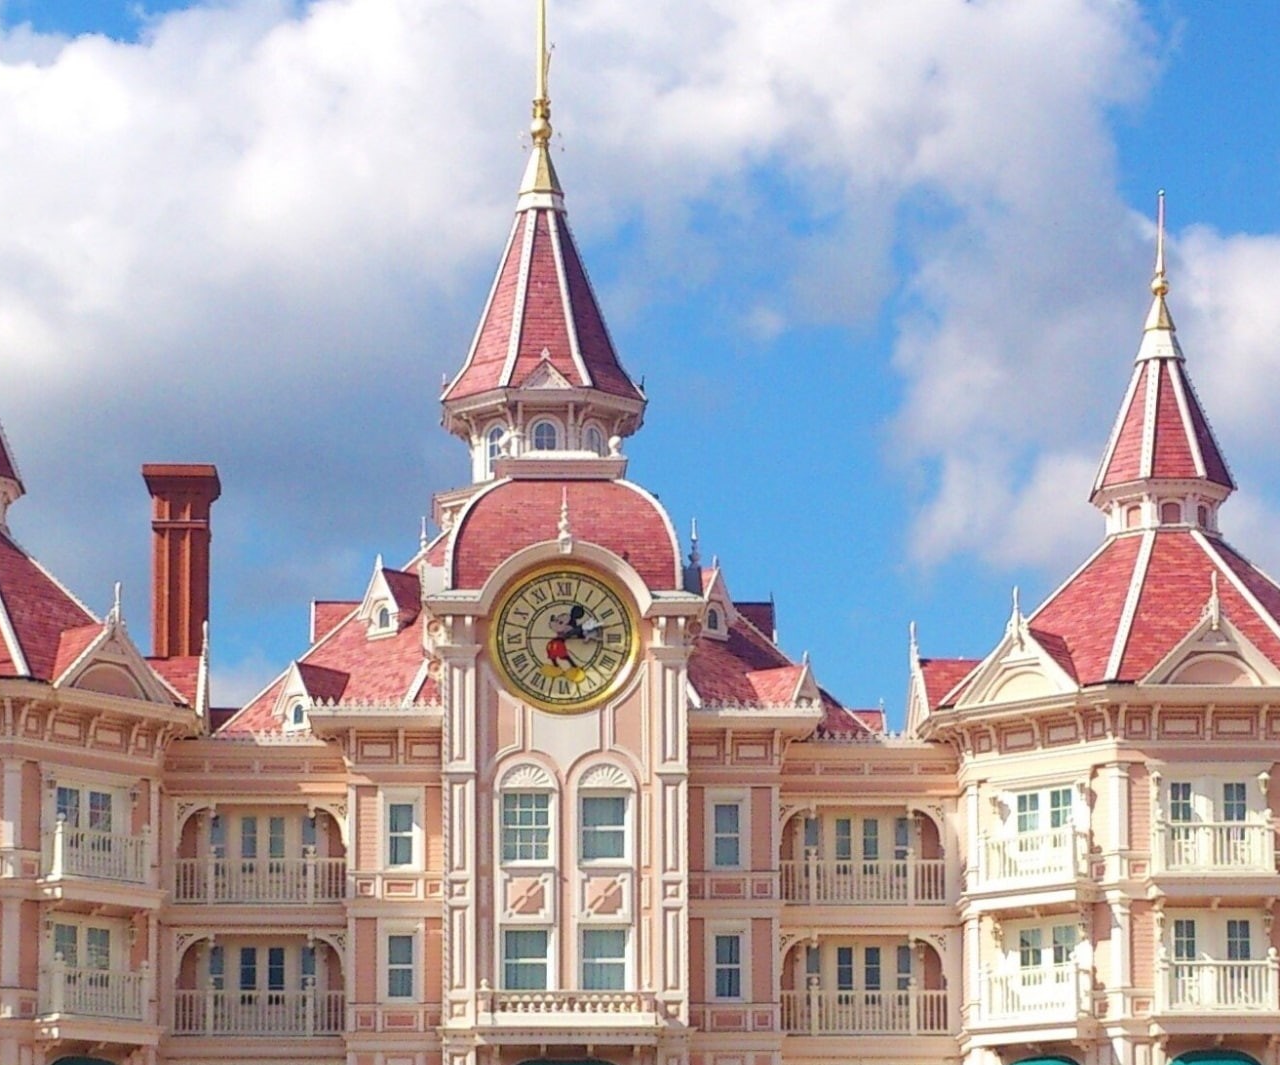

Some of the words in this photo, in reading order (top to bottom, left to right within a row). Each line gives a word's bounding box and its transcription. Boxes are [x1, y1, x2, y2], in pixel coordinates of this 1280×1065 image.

[556, 581, 572, 596] XII
[531, 587, 547, 604] XI
[600, 608, 615, 620] II
[607, 633, 622, 645] III
